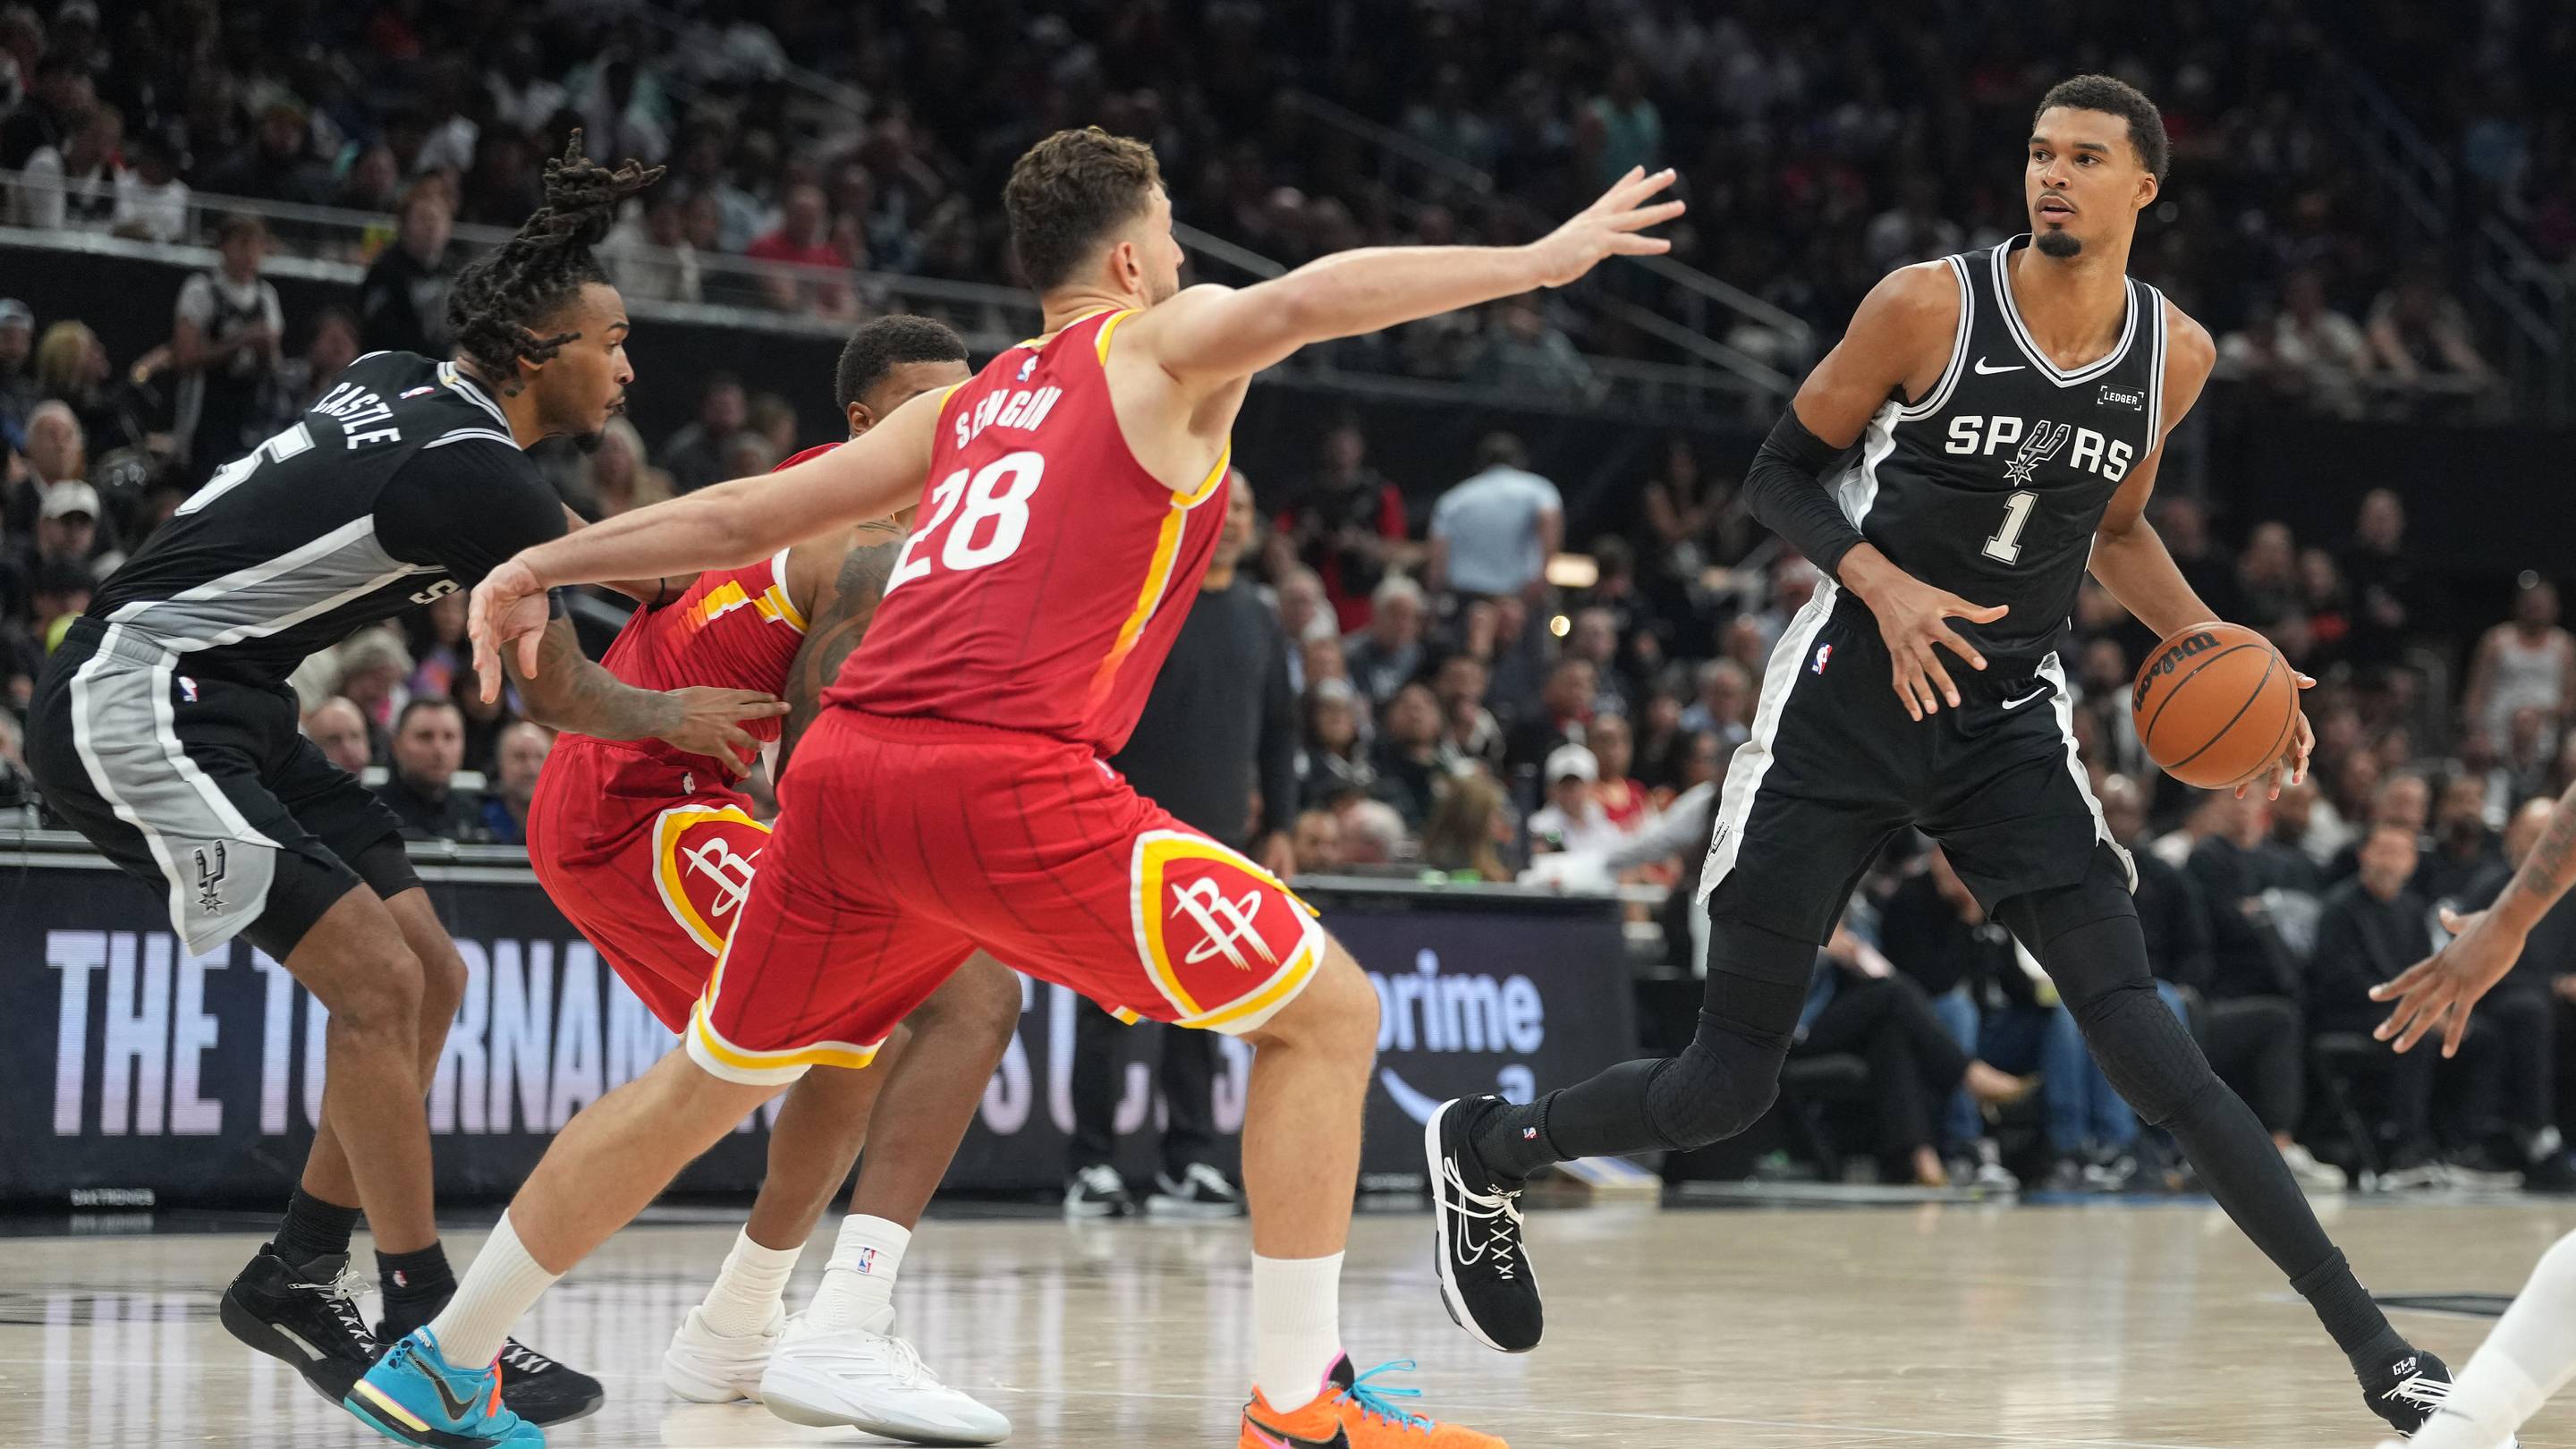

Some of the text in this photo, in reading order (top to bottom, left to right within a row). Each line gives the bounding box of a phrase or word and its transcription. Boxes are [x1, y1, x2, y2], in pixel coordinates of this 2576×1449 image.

[310, 382, 402, 450] CASTLE
[955, 386, 1063, 450] SENGUN
[2104, 391, 2139, 405] LEDGER
[882, 451, 1046, 598] 28
[1980, 489, 2039, 565] 1
[2134, 631, 2222, 712] Wilson
[46, 929, 231, 1136] THE
